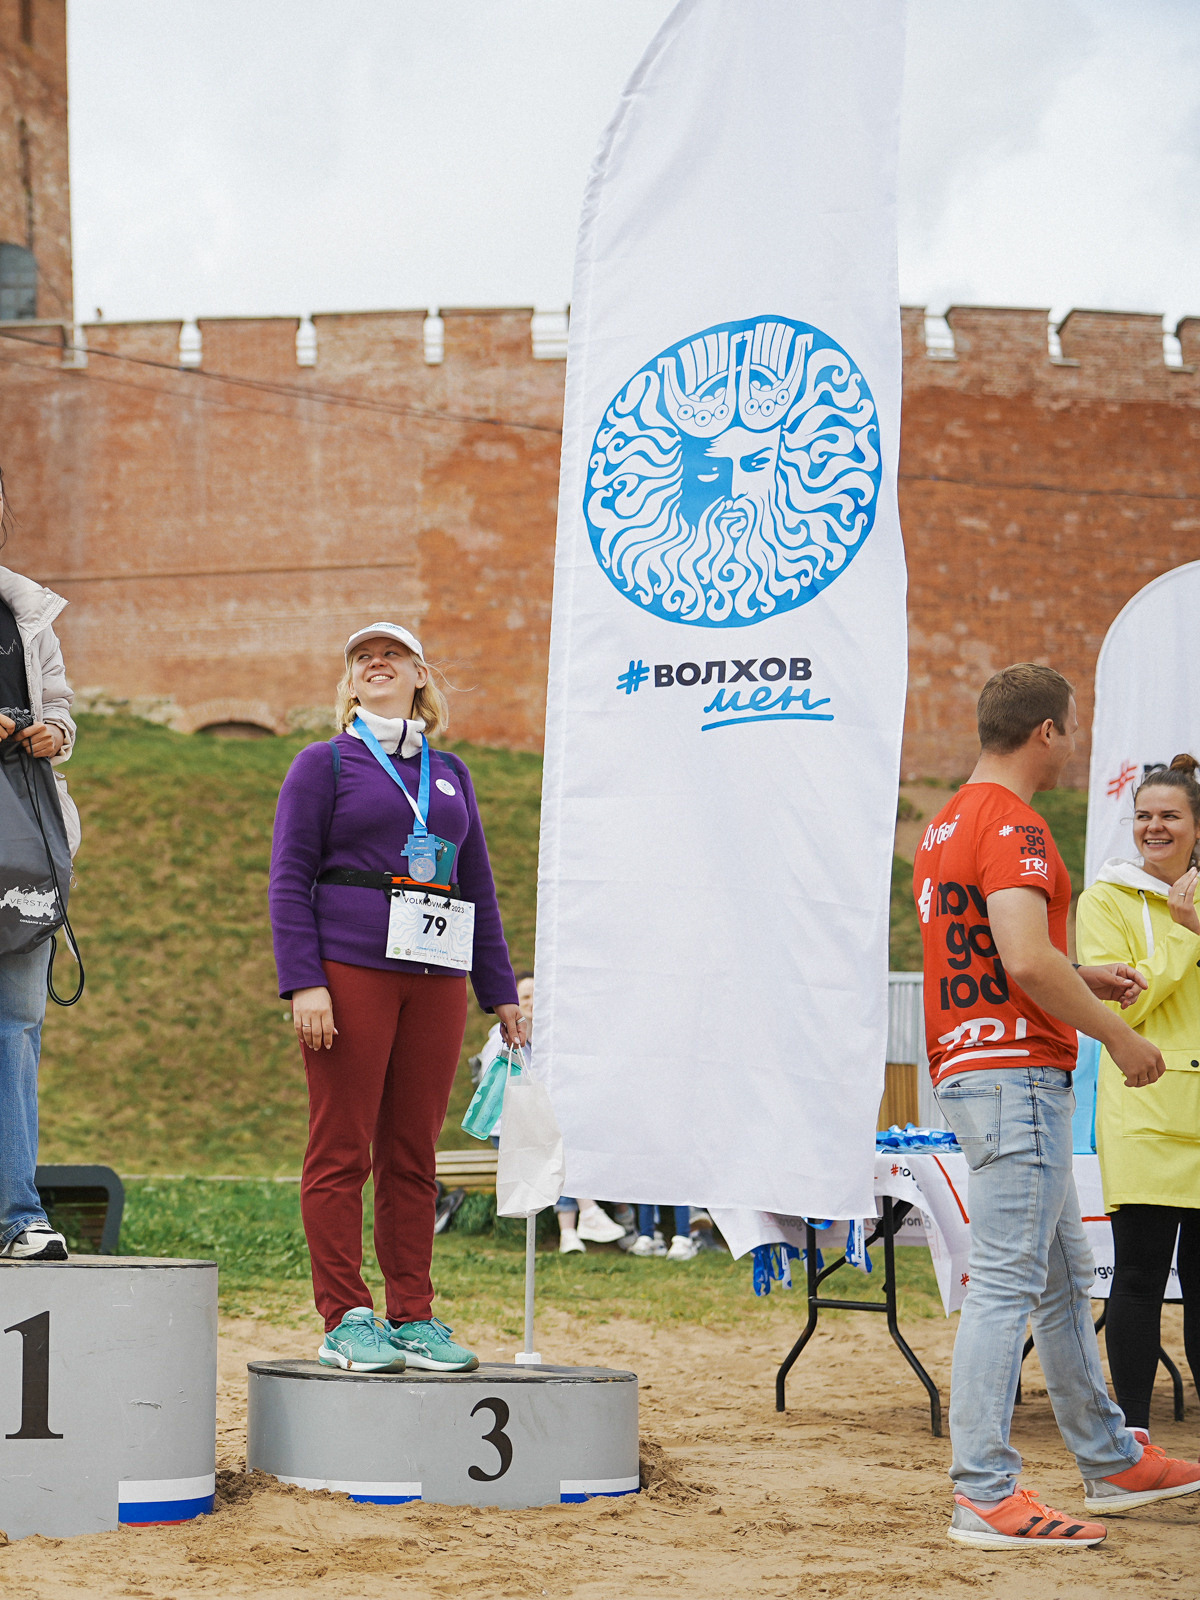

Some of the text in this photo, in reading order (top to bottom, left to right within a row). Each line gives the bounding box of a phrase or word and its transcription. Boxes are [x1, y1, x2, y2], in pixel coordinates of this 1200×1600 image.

[616, 657, 812, 695] #ВОЛХОВ
[999, 825, 1044, 837] #nov
[1025, 835, 1045, 846] go
[1020, 846, 1047, 859] rod
[1019, 858, 1048, 875] TRI
[10, 899, 50, 909] VERSTA
[423, 914, 447, 937] 79
[945, 921, 1000, 970] go
[4, 1311, 63, 1439] 1
[468, 1397, 513, 1481] 3
